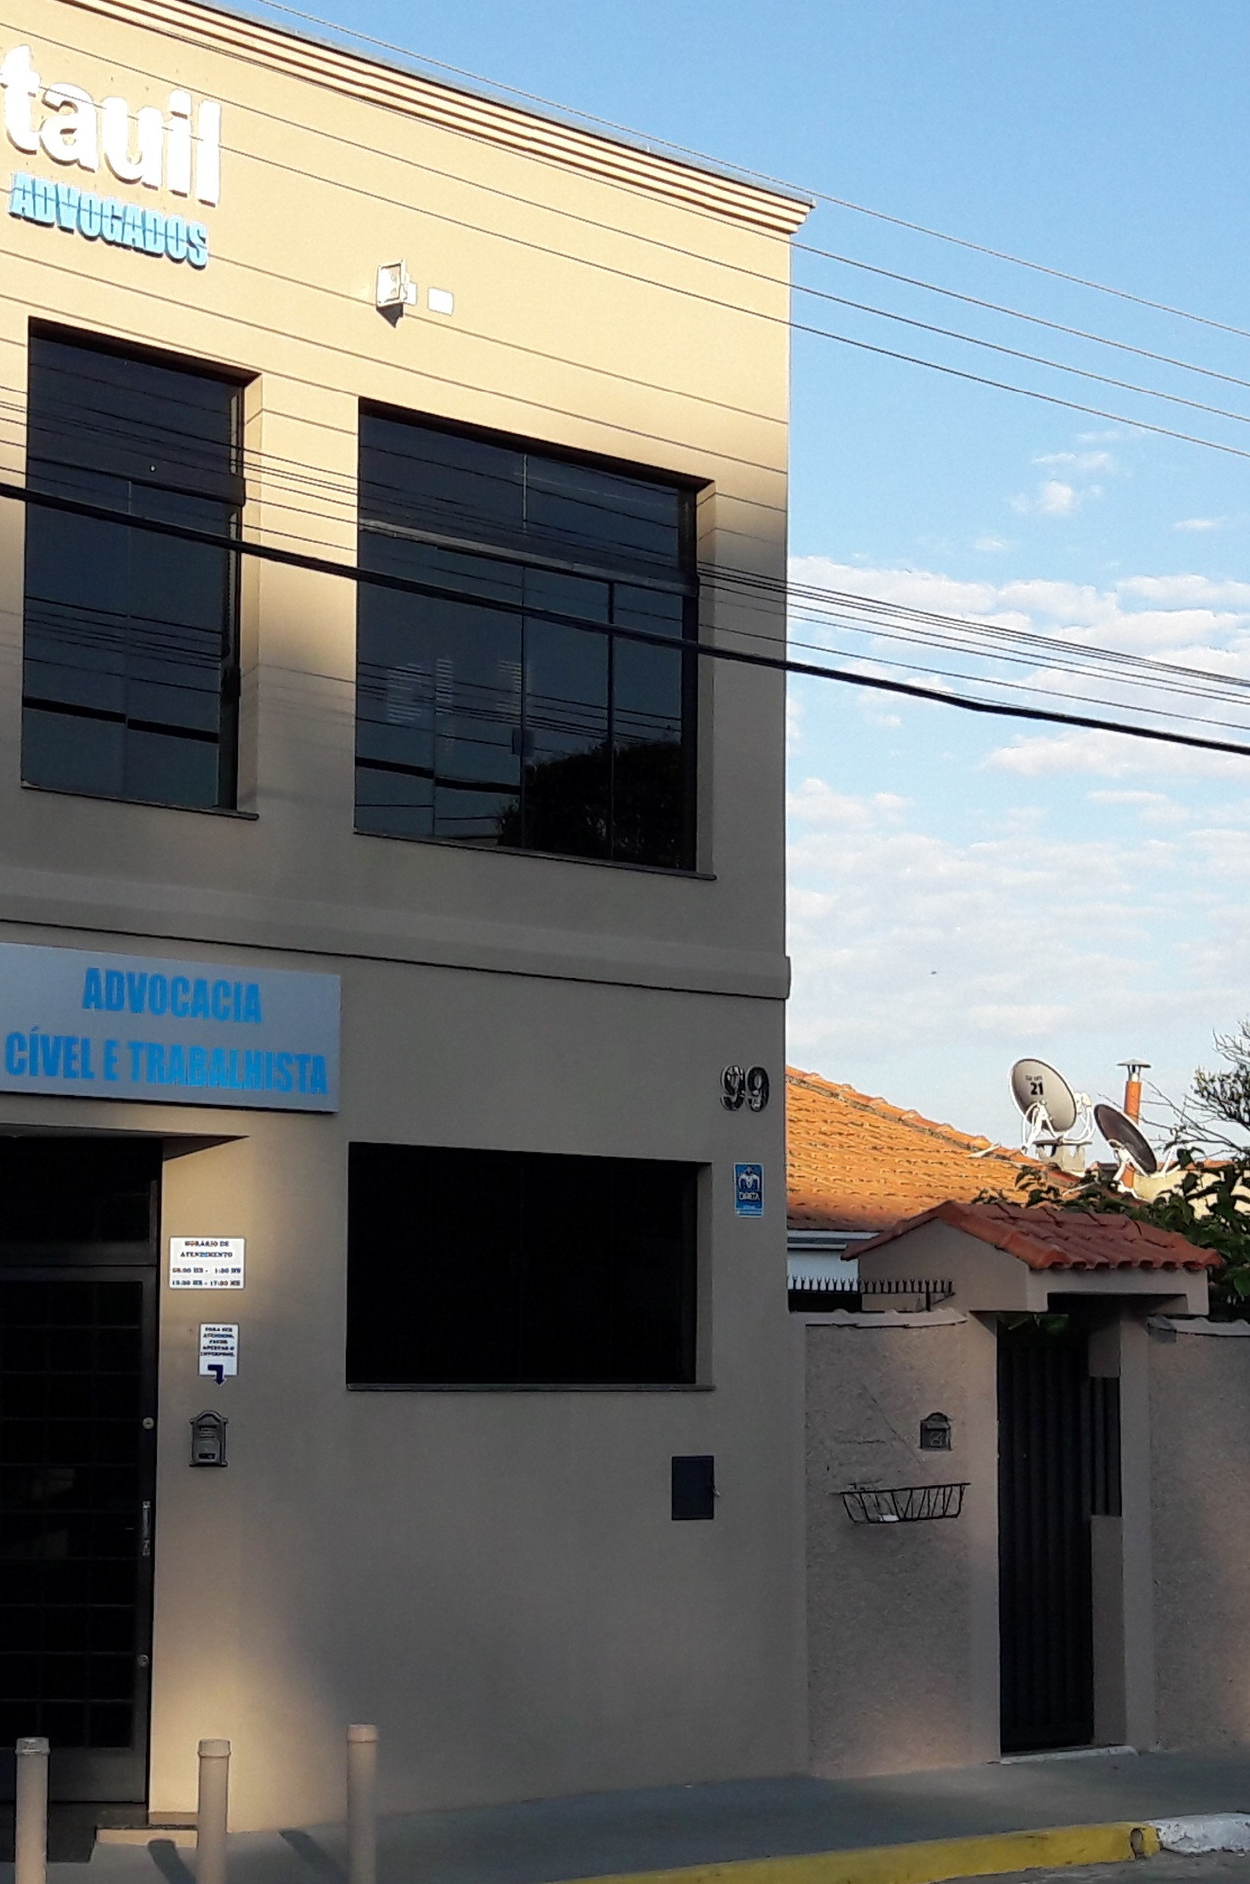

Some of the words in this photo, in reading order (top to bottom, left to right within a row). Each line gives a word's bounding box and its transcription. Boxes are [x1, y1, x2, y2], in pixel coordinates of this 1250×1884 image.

[8, 171, 209, 270] ADVOGADOS
[82, 967, 262, 1023] ADVOCACIA
[5, 1025, 94, 1079] CÍVEL
[103, 1039, 120, 1082] E
[126, 1040, 328, 1095] TRABALHISTA
[720, 1065, 770, 1113] 99
[1030, 1082, 1044, 1095] 21
